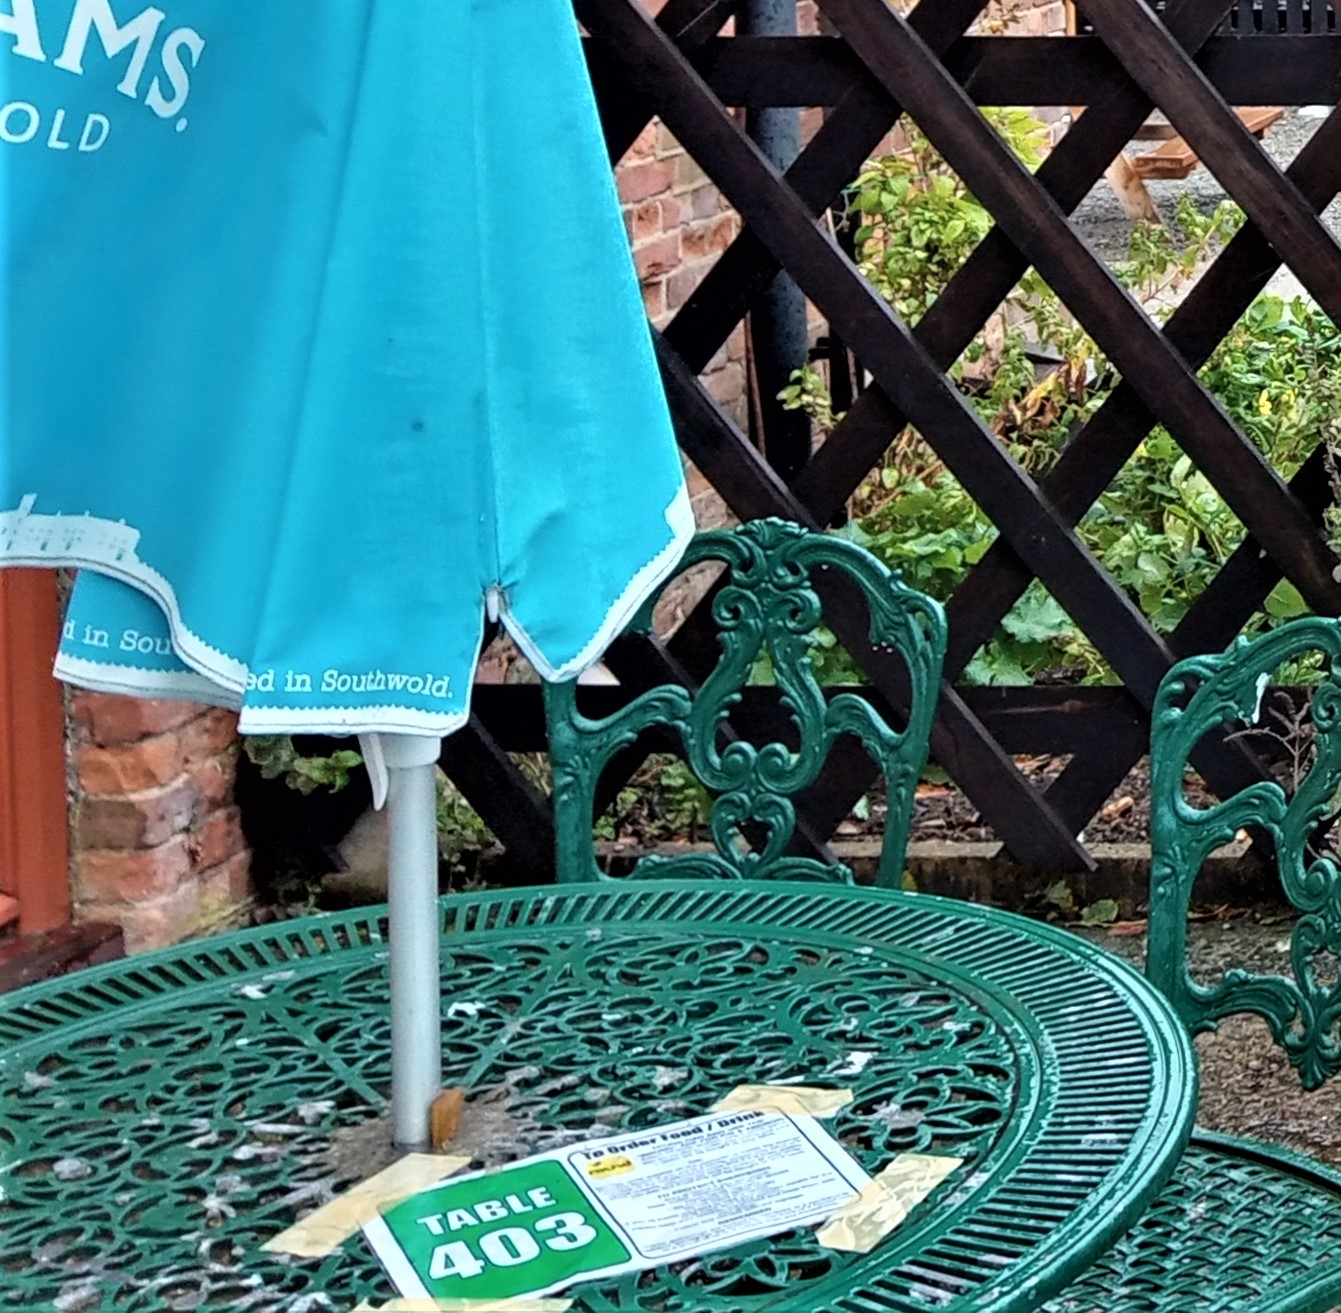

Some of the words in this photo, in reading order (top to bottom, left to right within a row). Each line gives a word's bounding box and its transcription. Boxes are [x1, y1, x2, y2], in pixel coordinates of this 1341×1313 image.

[0, 101, 111, 152] OLD
[83, 624, 109, 649] in
[284, 669, 312, 692] in
[321, 668, 454, 699] Southwold.
[583, 1149, 605, 1161] To
[607, 1137, 658, 1155] Order
[660, 1126, 704, 1142] Food
[717, 1111, 766, 1129] Drink
[416, 1186, 557, 1236] TABLE
[428, 1211, 598, 1280] 403
